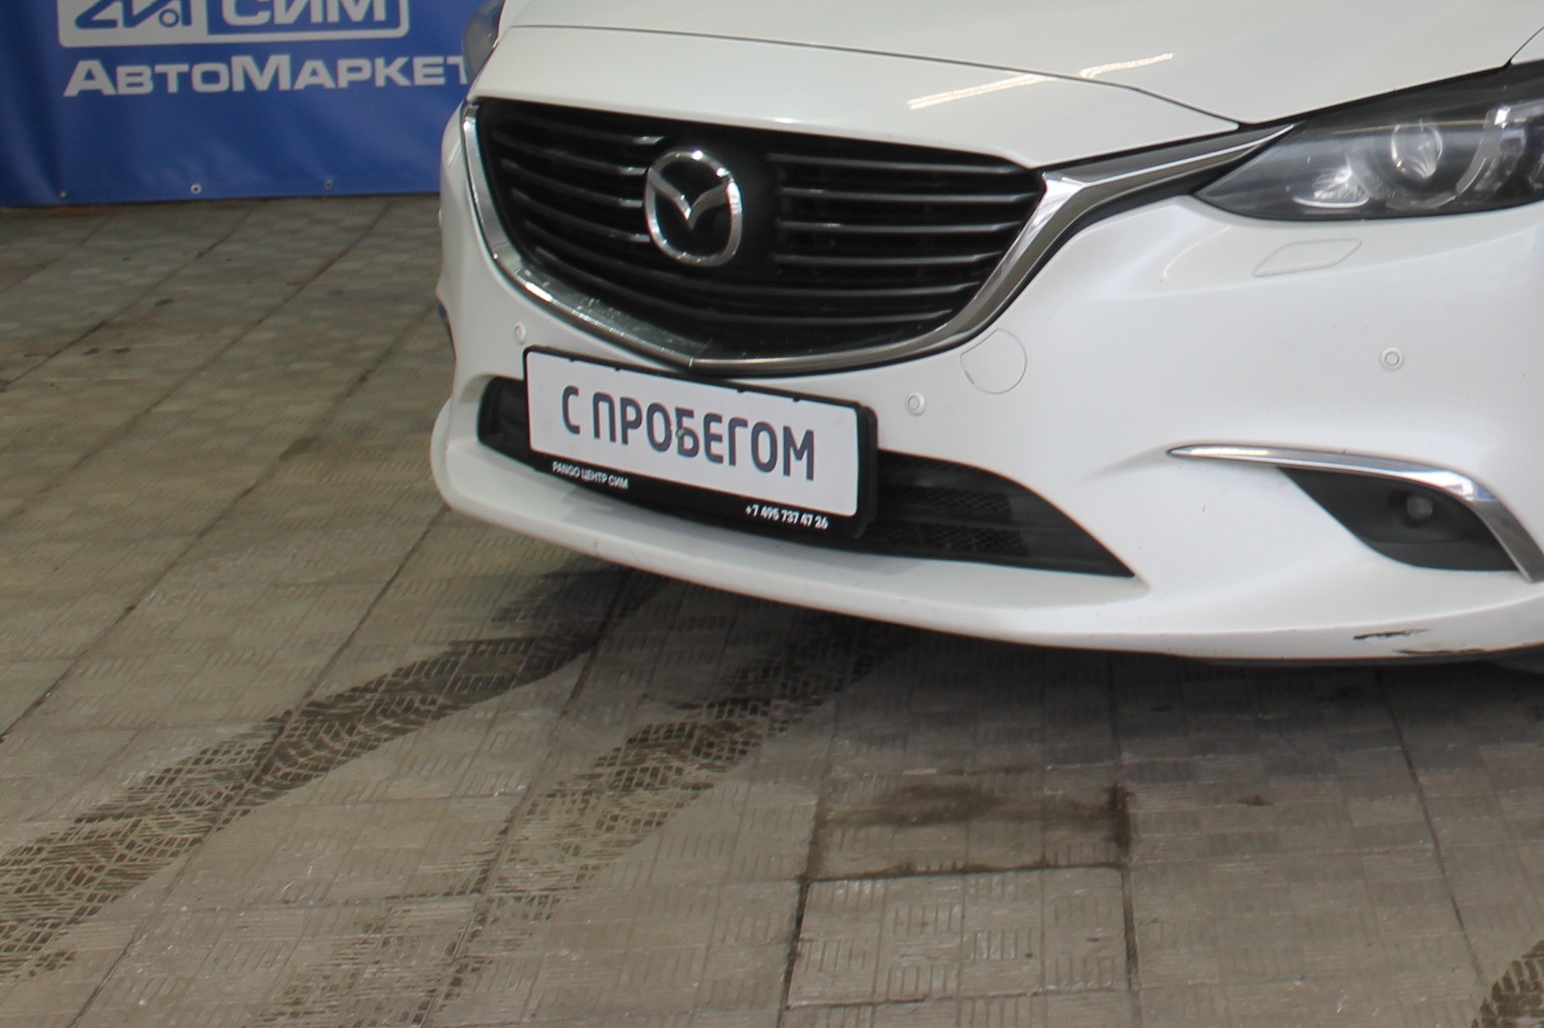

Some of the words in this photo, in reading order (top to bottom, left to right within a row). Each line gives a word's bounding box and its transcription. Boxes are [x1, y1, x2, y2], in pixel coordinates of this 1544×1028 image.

[562, 386, 580, 435] С
[592, 392, 814, 481] ПРОБЕГОМ
[761, 506, 779, 520] 495
